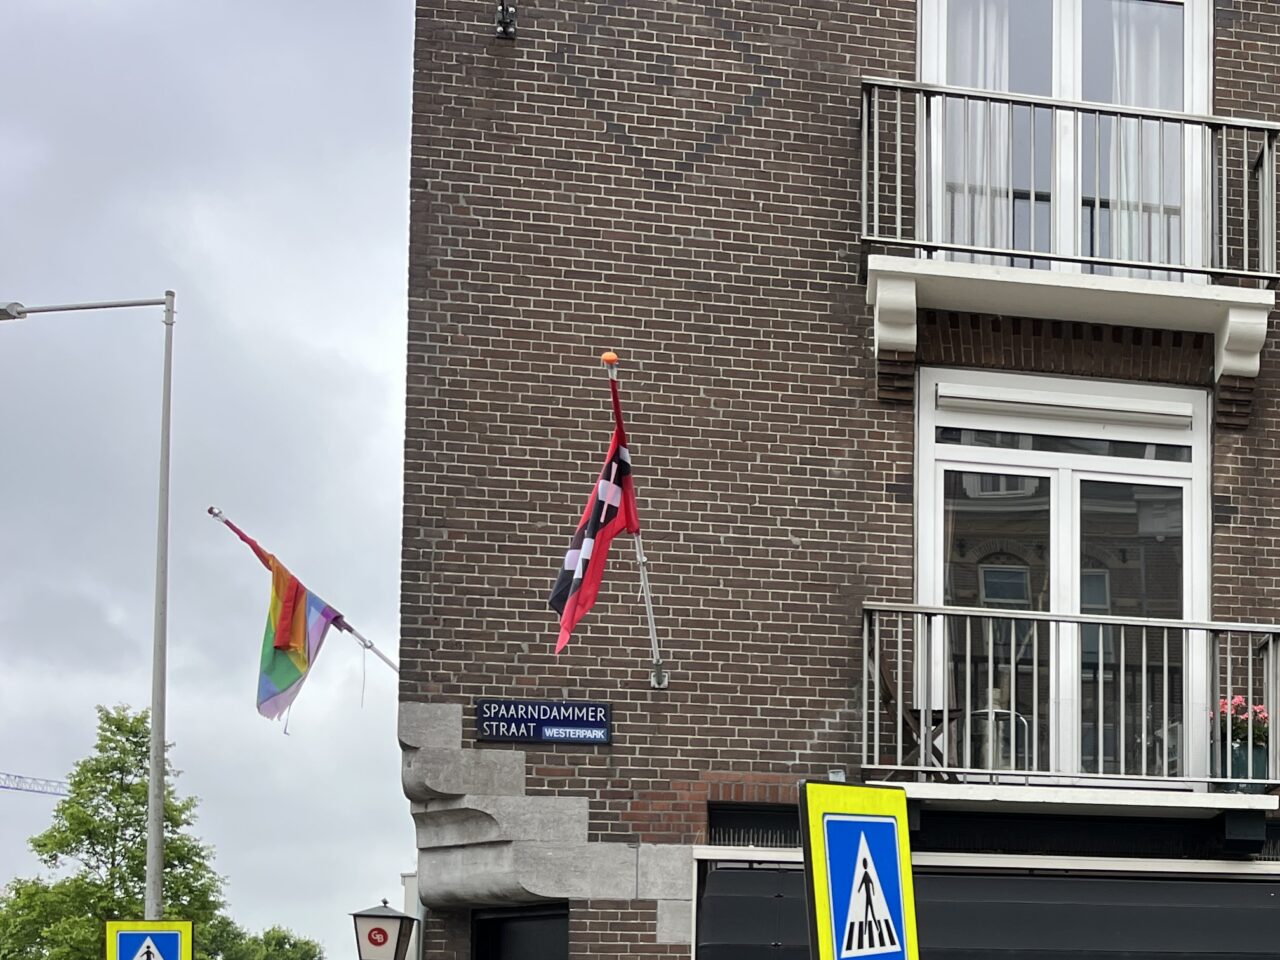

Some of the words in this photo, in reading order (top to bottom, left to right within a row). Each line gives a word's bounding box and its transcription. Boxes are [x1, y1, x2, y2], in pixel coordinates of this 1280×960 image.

[482, 703, 607, 721] SPAARNDAMMER
[482, 721, 537, 737] STRAAT
[544, 728, 605, 739] WESTERPARK
